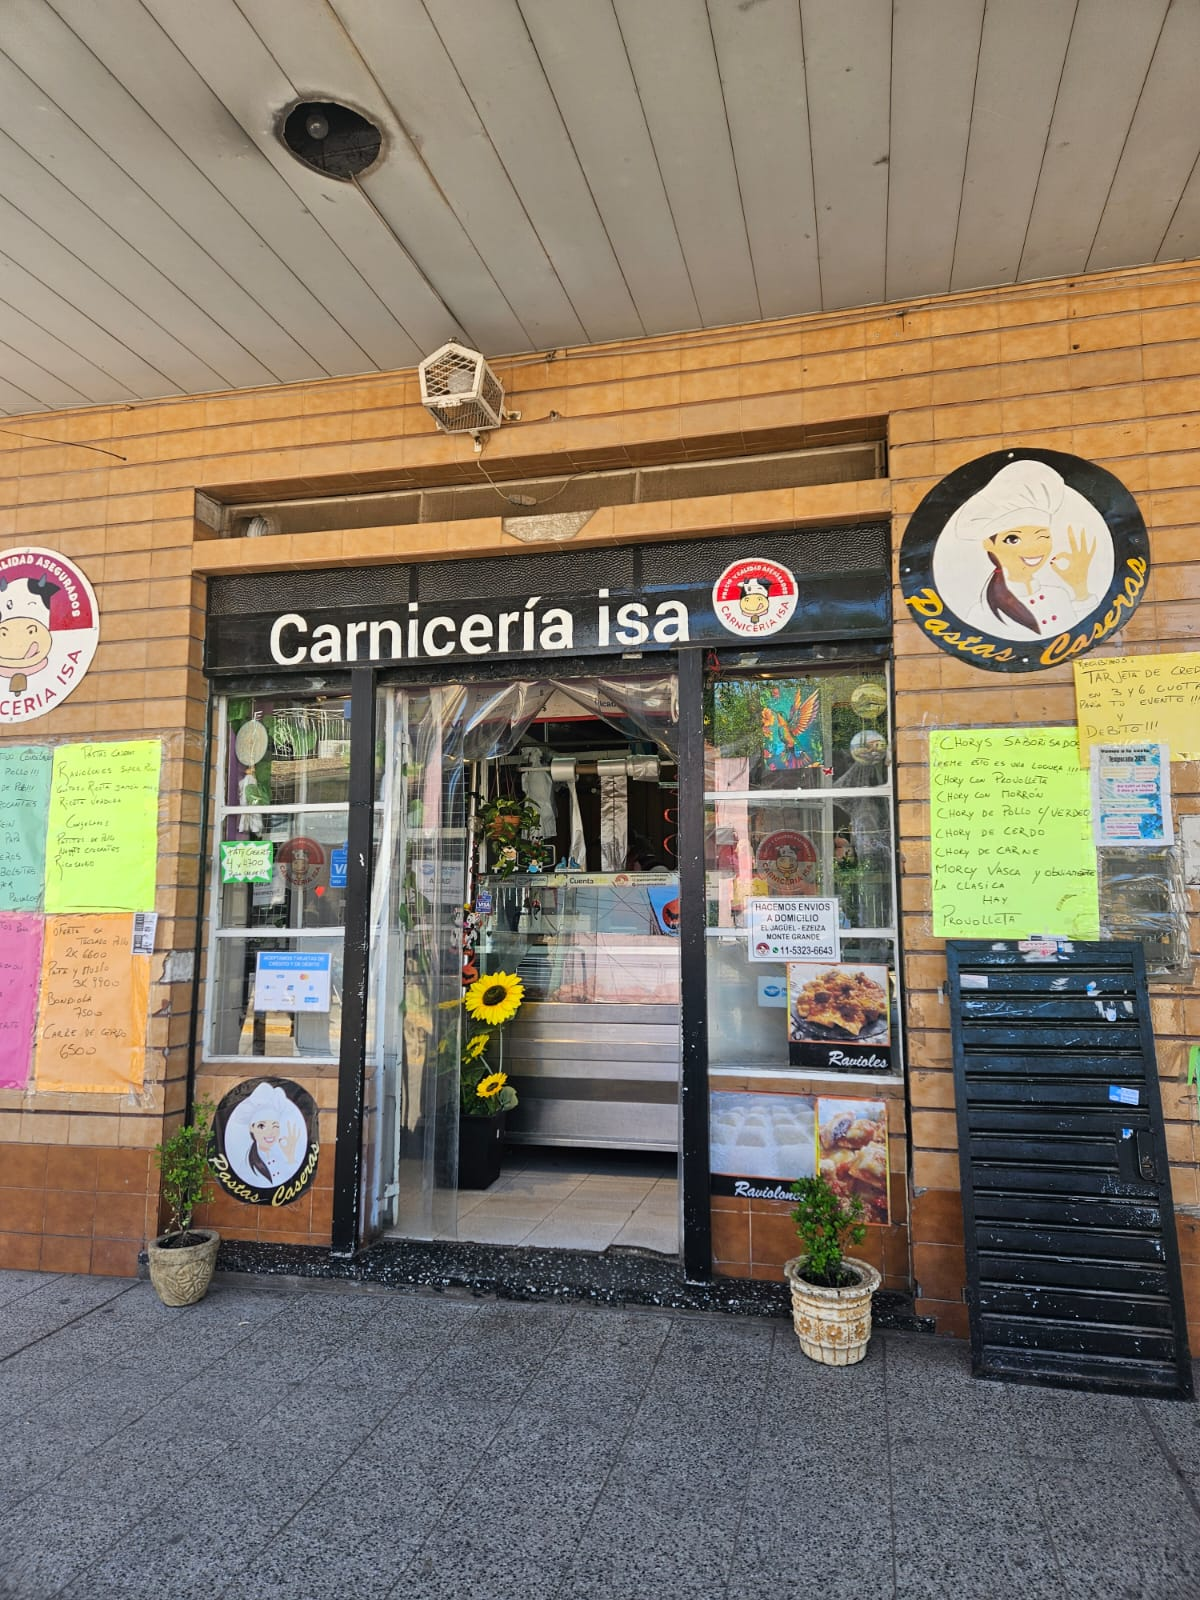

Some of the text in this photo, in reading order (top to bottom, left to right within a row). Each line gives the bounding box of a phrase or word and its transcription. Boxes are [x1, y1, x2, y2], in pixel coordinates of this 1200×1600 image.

[0, 555, 80, 618] LIDAD ASEGURADOS
[721, 601, 790, 632] CARNICERIA ISA
[904, 556, 1147, 665] Pastas Caseras
[269, 588, 690, 666] Carnicería isa
[57, 650, 82, 685] ISA
[1081, 669, 1141, 685] TARJETA
[1145, 669, 1161, 678] DE
[1111, 688, 1122, 696] 3
[1138, 685, 1145, 695] 6
[1140, 695, 1185, 706] EVENTO
[982, 809, 994, 817] DE
[1001, 805, 1031, 817] POLLO
[981, 829, 994, 837] DE
[1003, 827, 1046, 838] CERDO
[996, 846, 1040, 856] CARNE
[987, 862, 1021, 877] VASCA
[569, 877, 594, 885] Cuenta
[982, 894, 1008, 905] HAY
[755, 903, 831, 911] HACEMOS ENVIOS
[766, 913, 819, 922] A DOMICILIO
[780, 946, 833, 955] 11-5323-6643
[59, 1044, 97, 1060] 6500
[828, 1050, 889, 1069] Ravioles
[208, 1140, 320, 1207] Pastas Caseras
